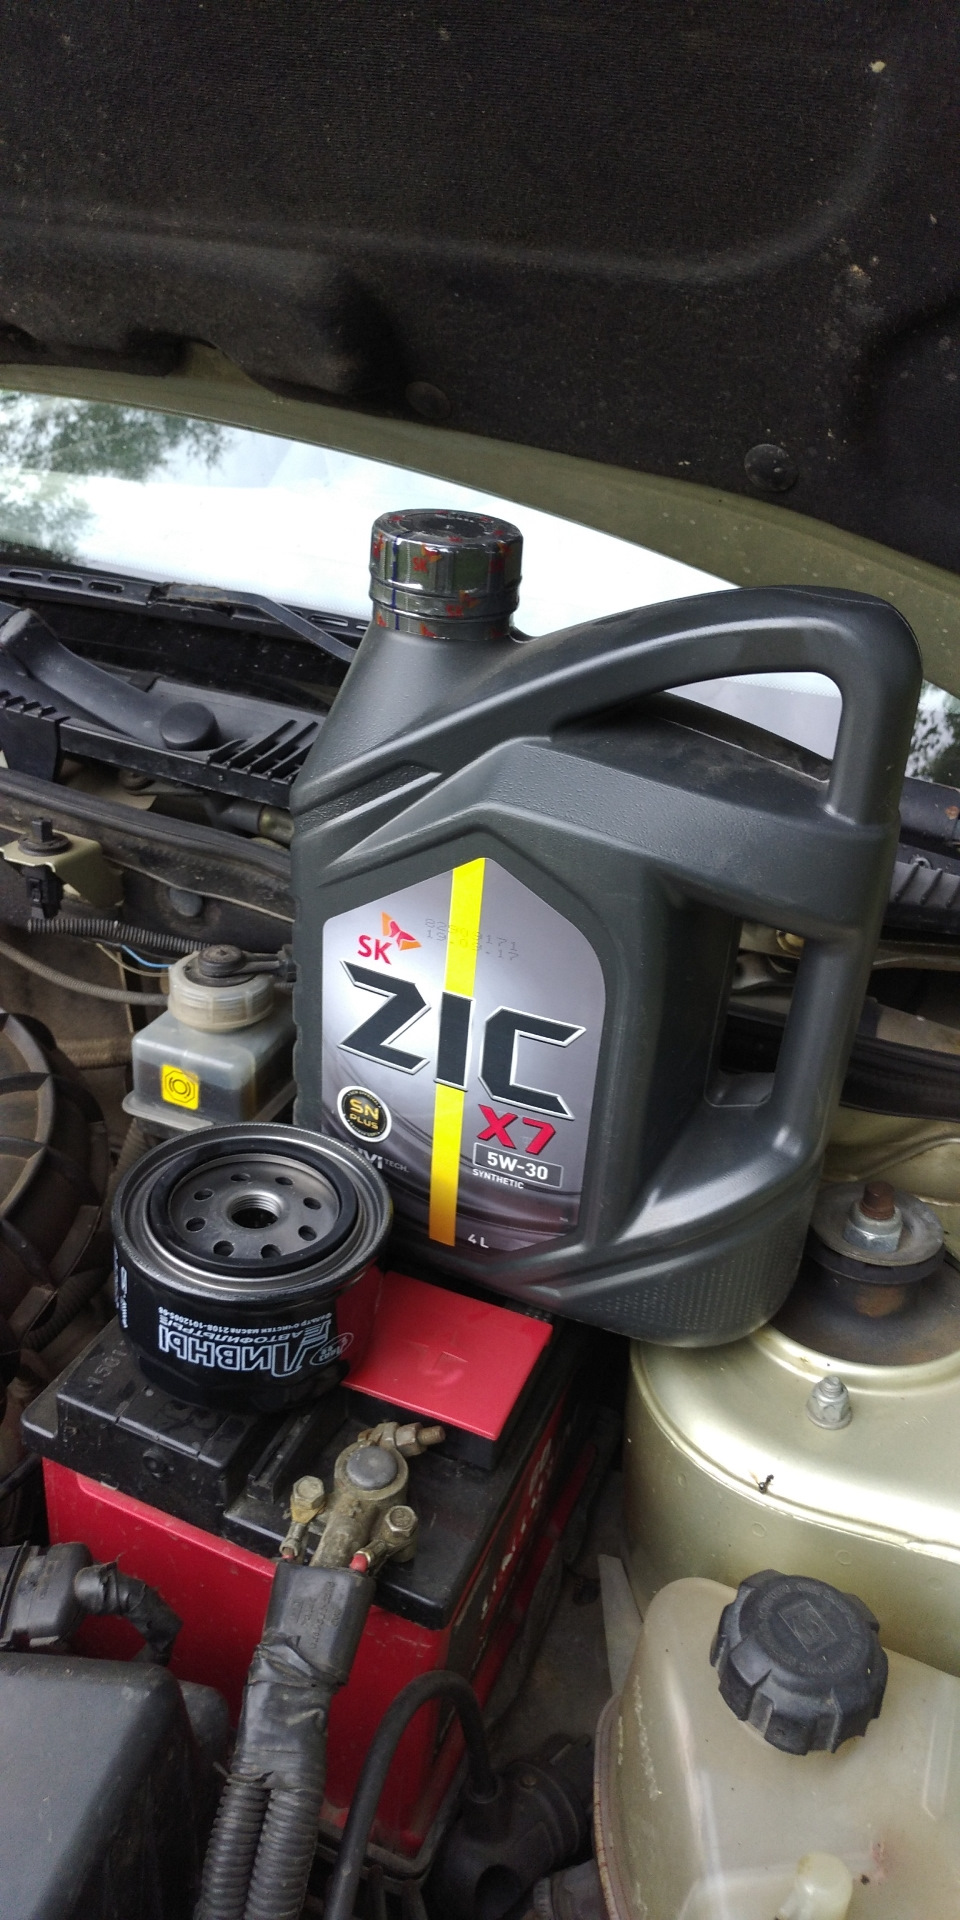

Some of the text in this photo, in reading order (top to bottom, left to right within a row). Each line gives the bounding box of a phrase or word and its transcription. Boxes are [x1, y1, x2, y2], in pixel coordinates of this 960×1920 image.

[357, 934, 392, 965] SK
[337, 959, 587, 1120] ZIC
[349, 1098, 380, 1121] SN
[349, 1113, 379, 1131] PLUS
[477, 1104, 557, 1155] X7
[472, 1168, 525, 1190] SYNTHETIC
[487, 1151, 549, 1181] 5W-30
